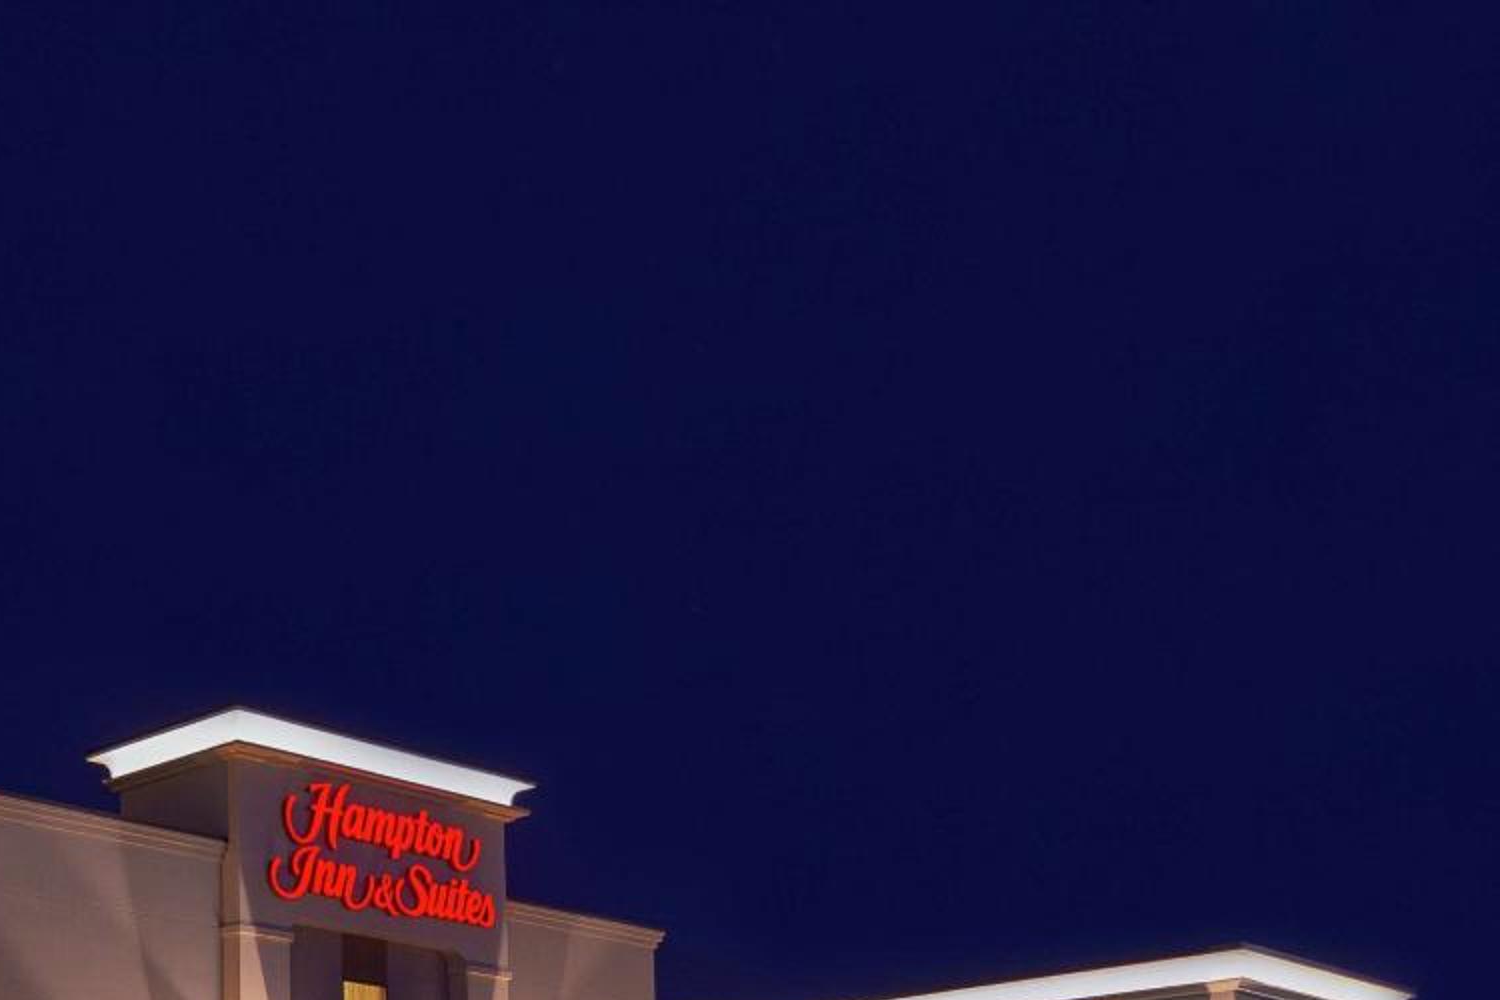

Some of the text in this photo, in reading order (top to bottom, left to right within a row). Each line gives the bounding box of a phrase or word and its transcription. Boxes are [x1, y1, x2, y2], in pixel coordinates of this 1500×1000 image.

[283, 782, 482, 872] Hampton
[269, 845, 496, 929] Inn & Suites
